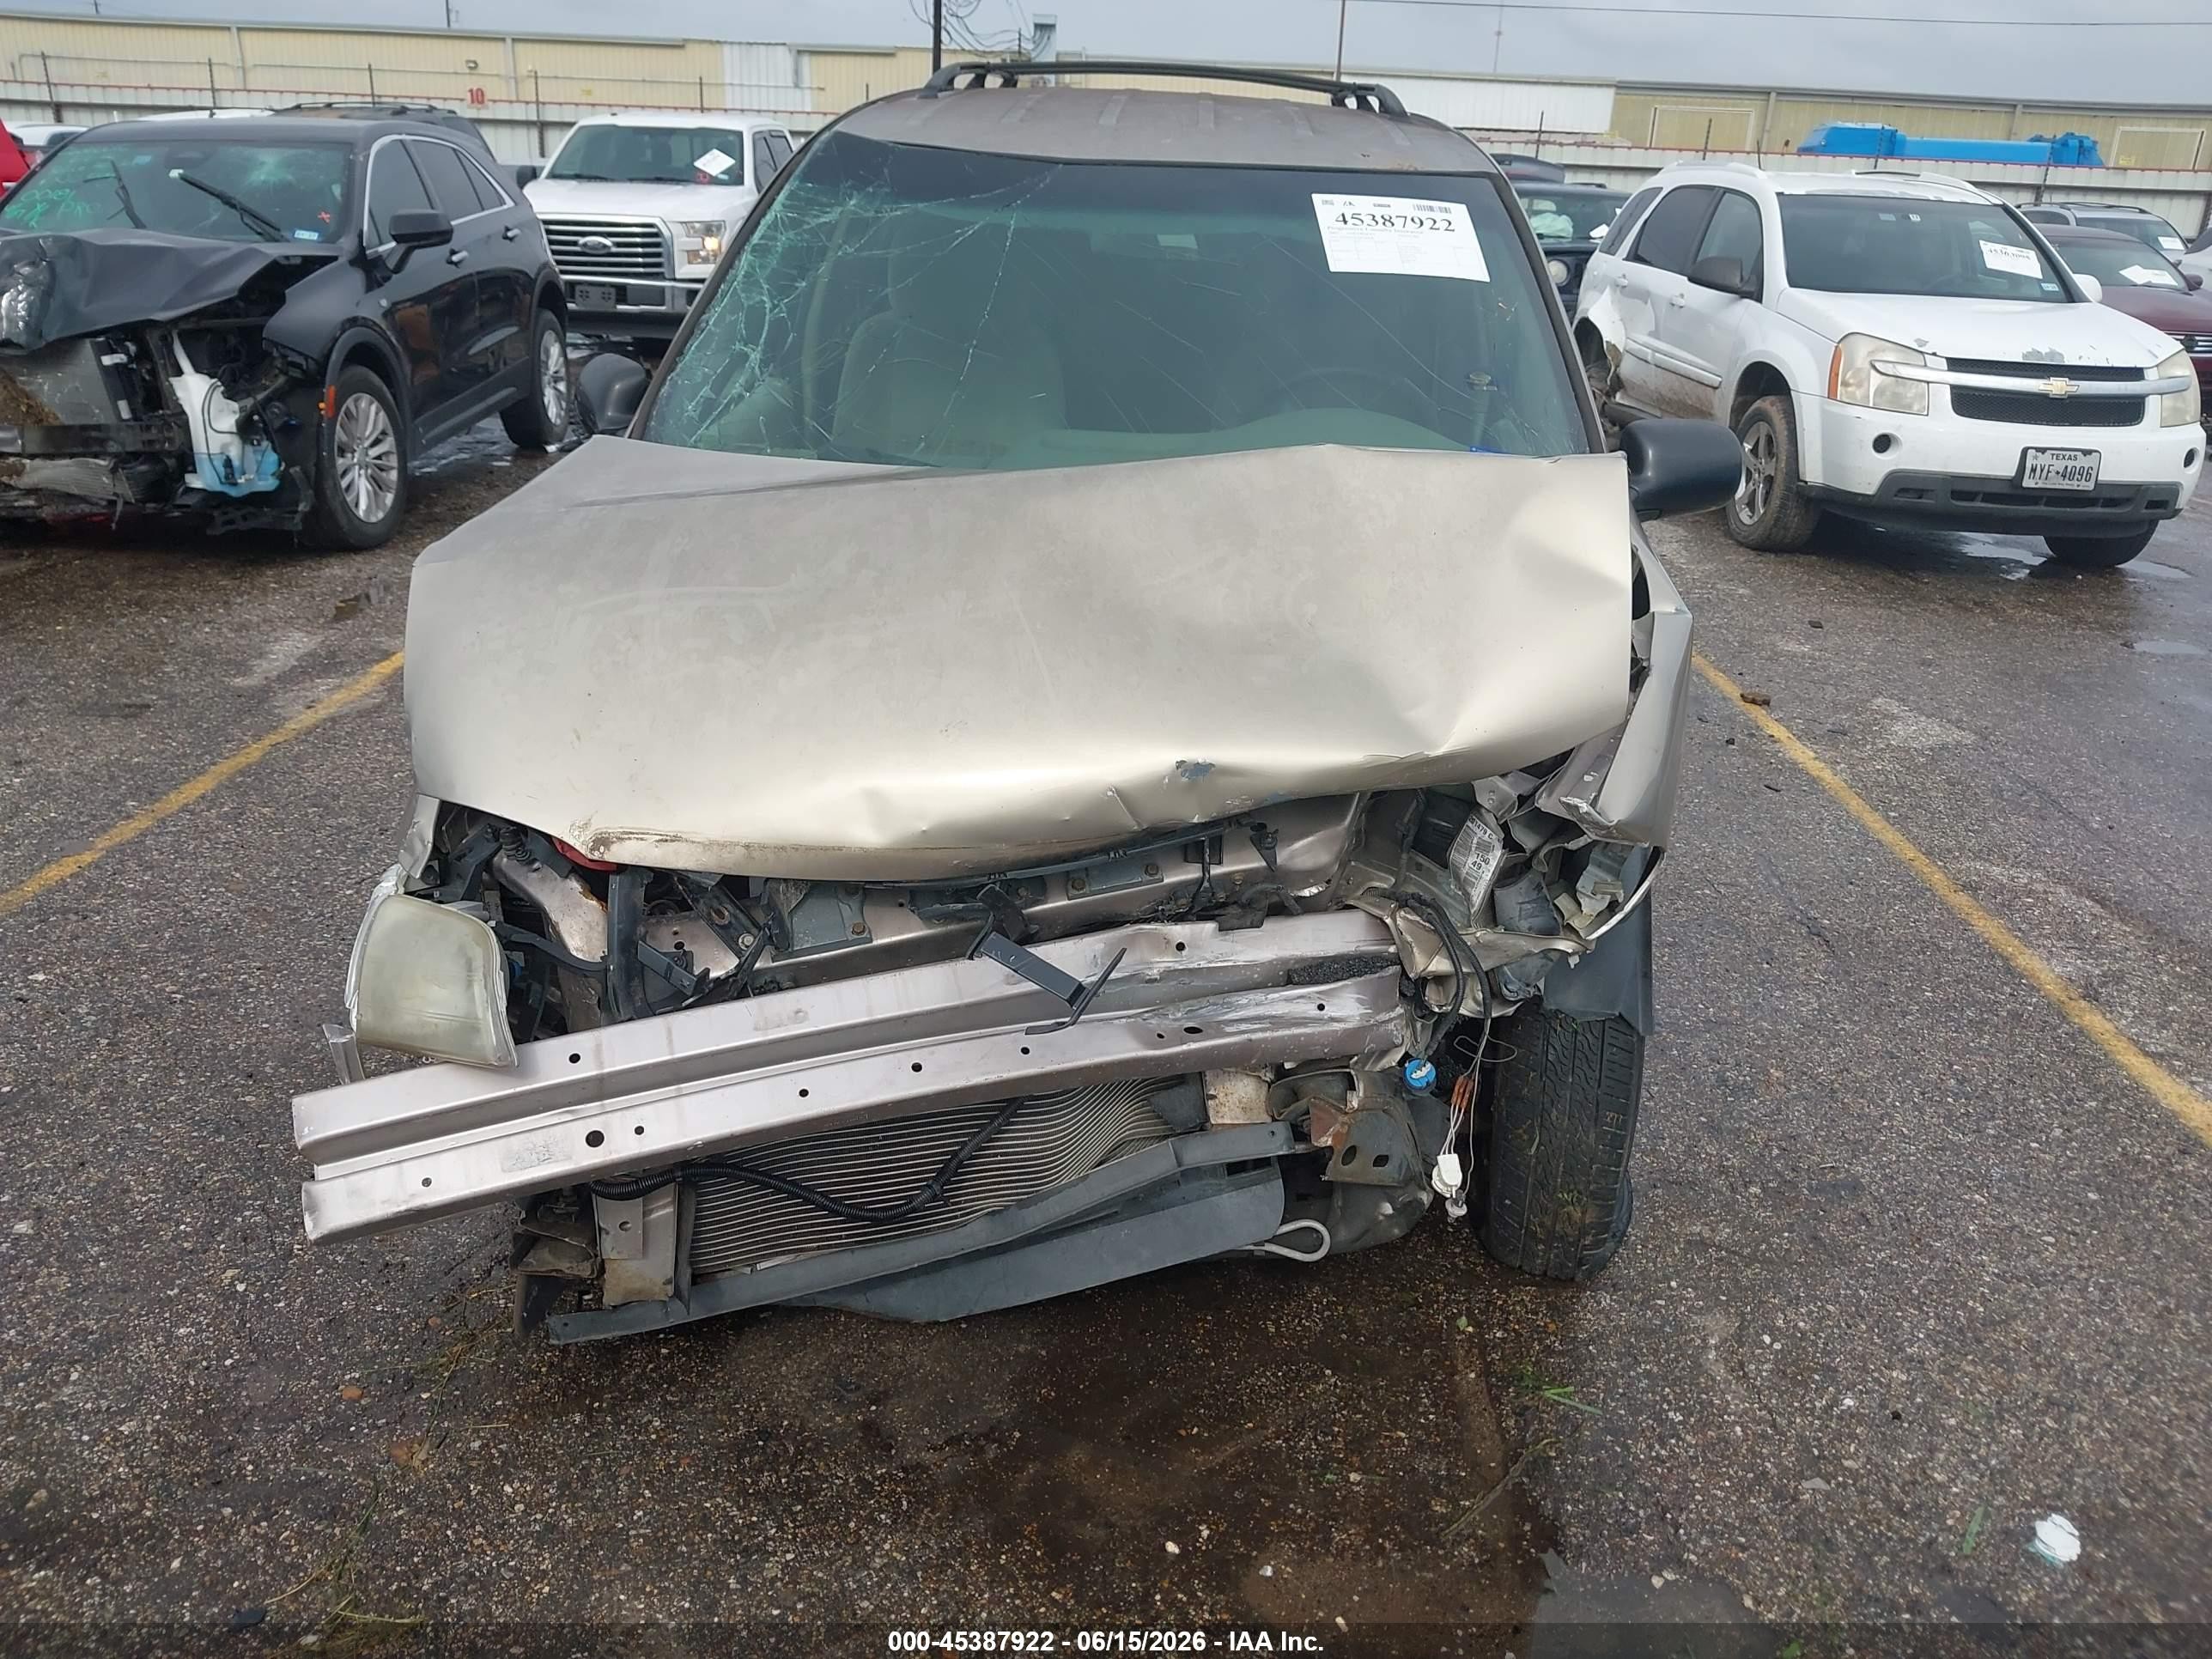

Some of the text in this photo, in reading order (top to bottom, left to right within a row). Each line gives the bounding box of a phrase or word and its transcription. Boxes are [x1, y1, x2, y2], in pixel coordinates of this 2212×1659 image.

[468, 88, 485, 104] 10
[1334, 212, 1455, 233] 45387922
[2050, 453, 2079, 461] TEXAS
[2060, 465, 2094, 483] 4096
[1471, 860, 1482, 871] 49
[1475, 853, 1491, 866] 150
